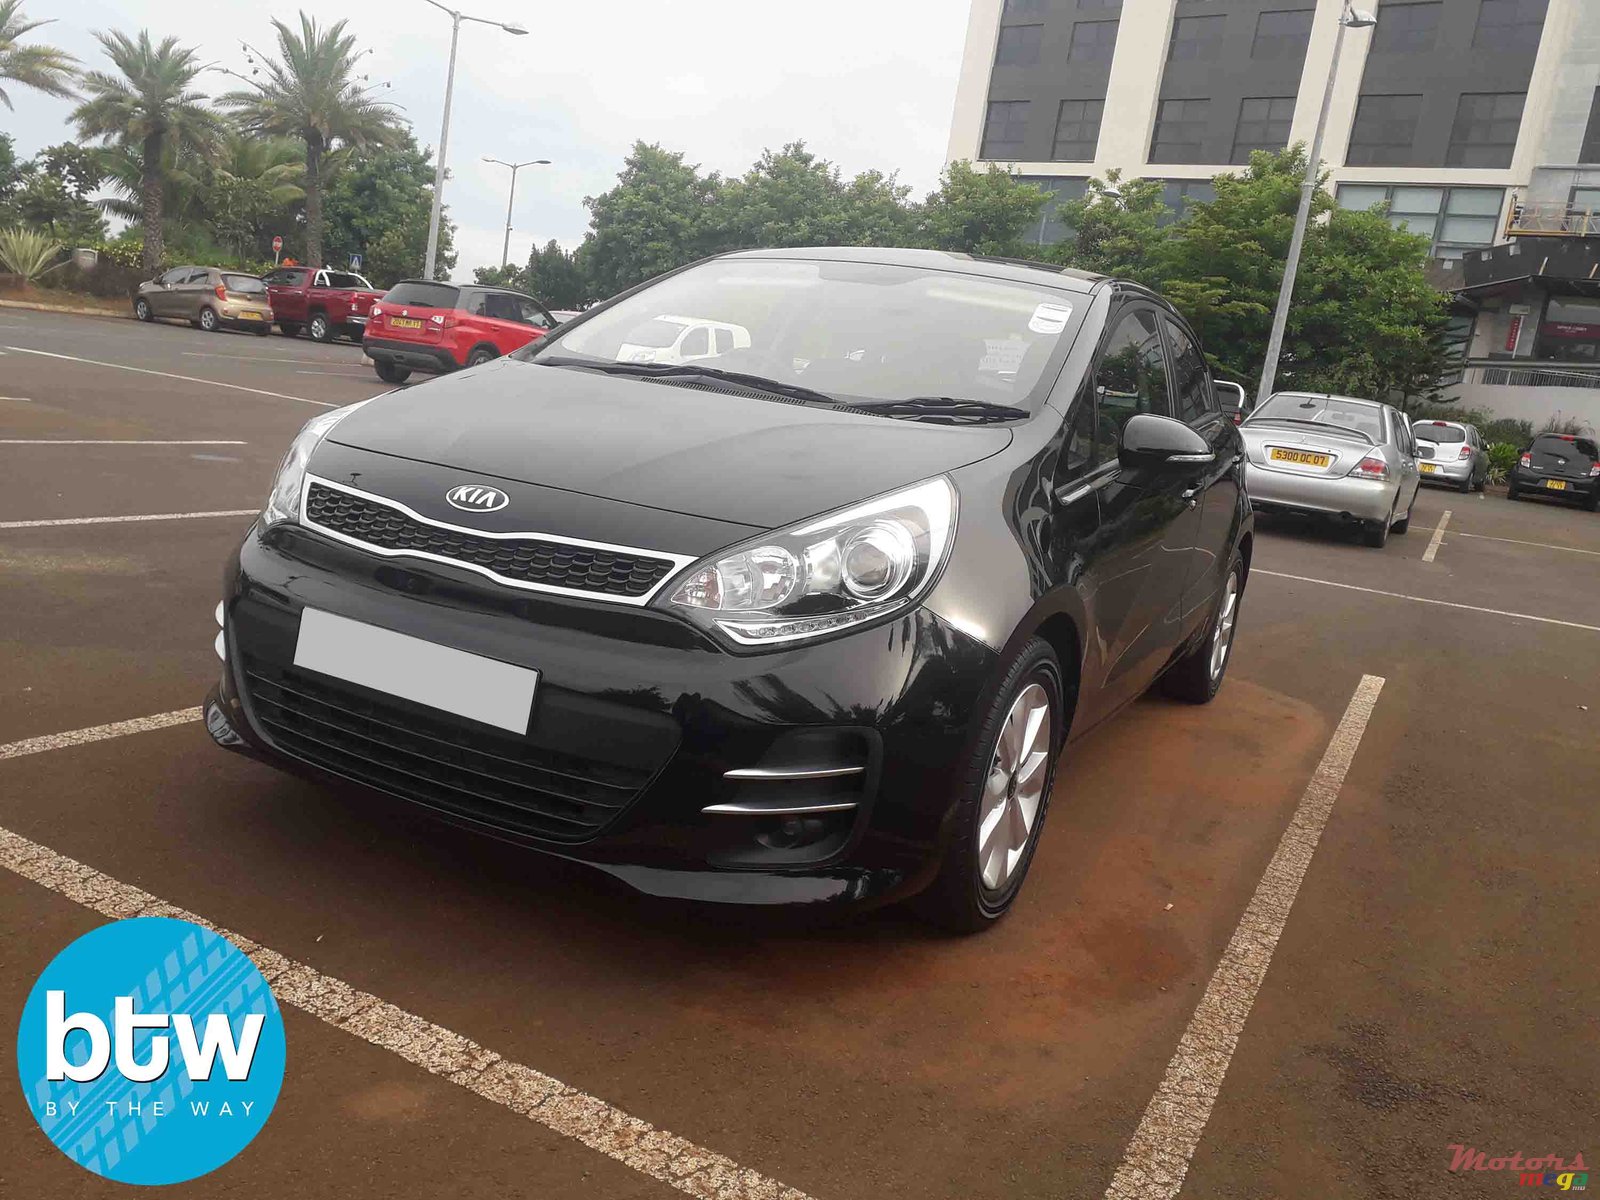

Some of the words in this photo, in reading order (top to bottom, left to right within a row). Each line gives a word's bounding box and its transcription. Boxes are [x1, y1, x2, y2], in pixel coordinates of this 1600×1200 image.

[1276, 450, 1298, 461] 5300
[1313, 455, 1326, 465] 07
[452, 486, 497, 508] KIA
